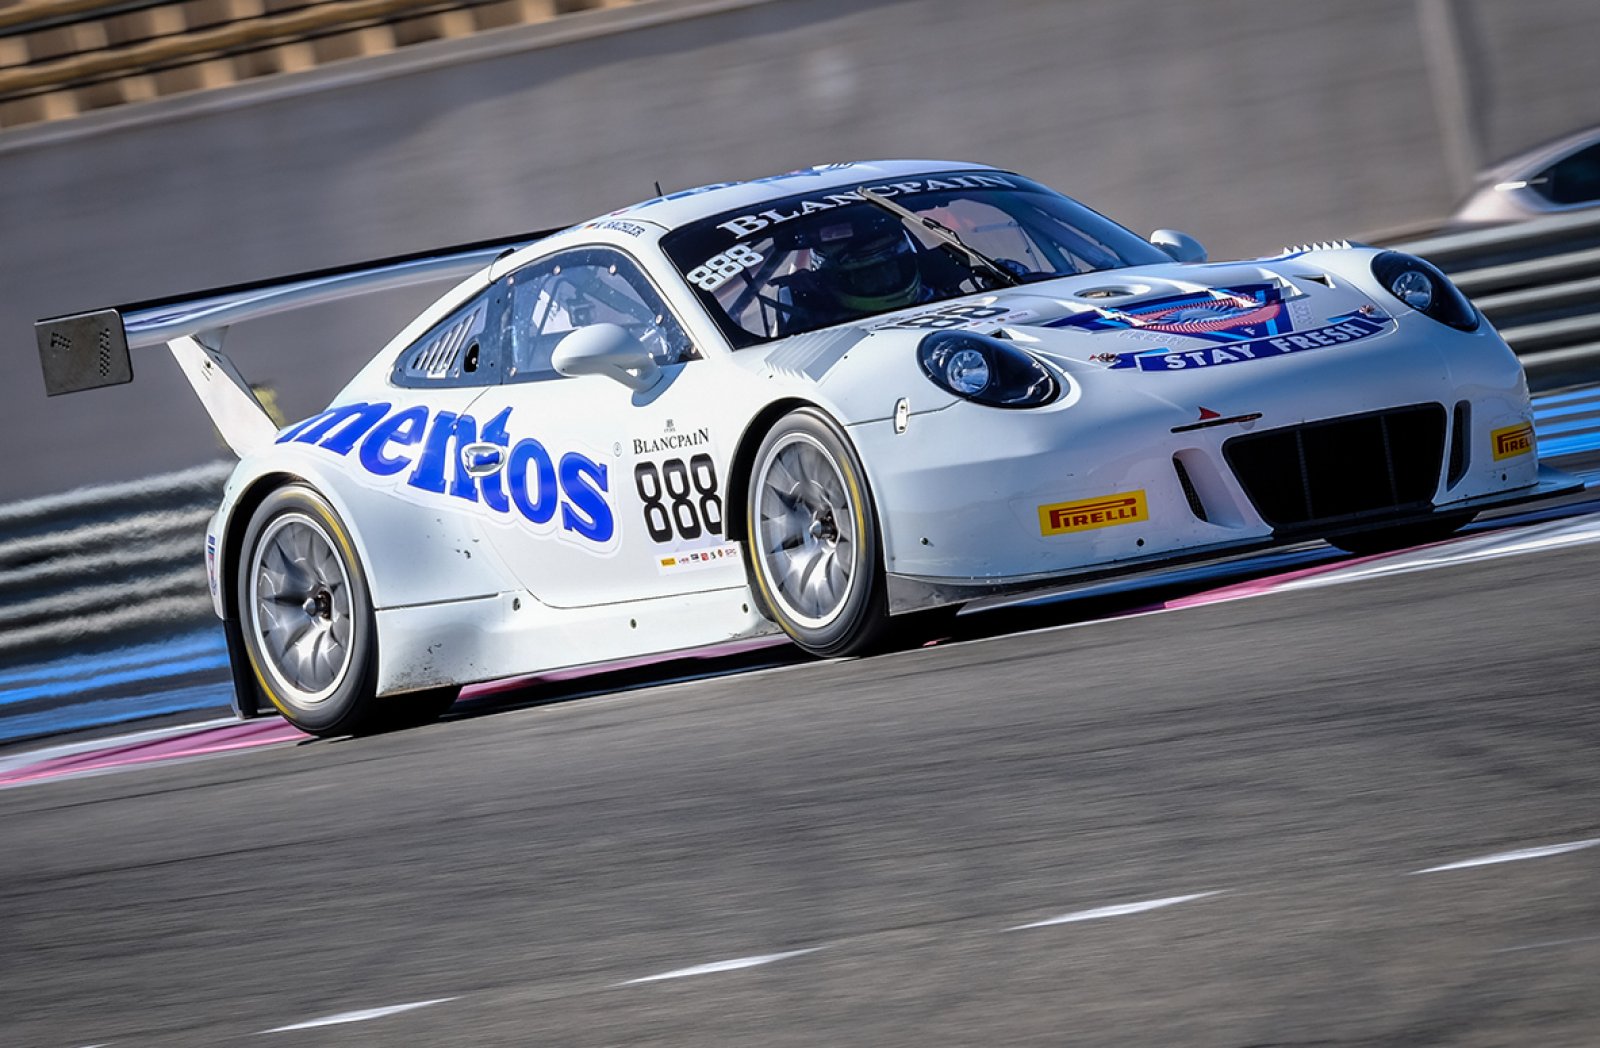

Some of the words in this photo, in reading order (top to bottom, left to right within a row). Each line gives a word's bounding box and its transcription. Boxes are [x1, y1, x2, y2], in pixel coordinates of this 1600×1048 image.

[717, 175, 1018, 239] BLANCPAIN
[687, 244, 764, 291] 888
[876, 306, 1010, 330] 88
[1164, 345, 1256, 370] STAY
[1271, 319, 1370, 352] FRESH
[633, 428, 710, 455] BLANCPAIN
[275, 402, 614, 543] mentos
[634, 453, 722, 543] 888
[1049, 498, 1138, 529] PIRELLI
